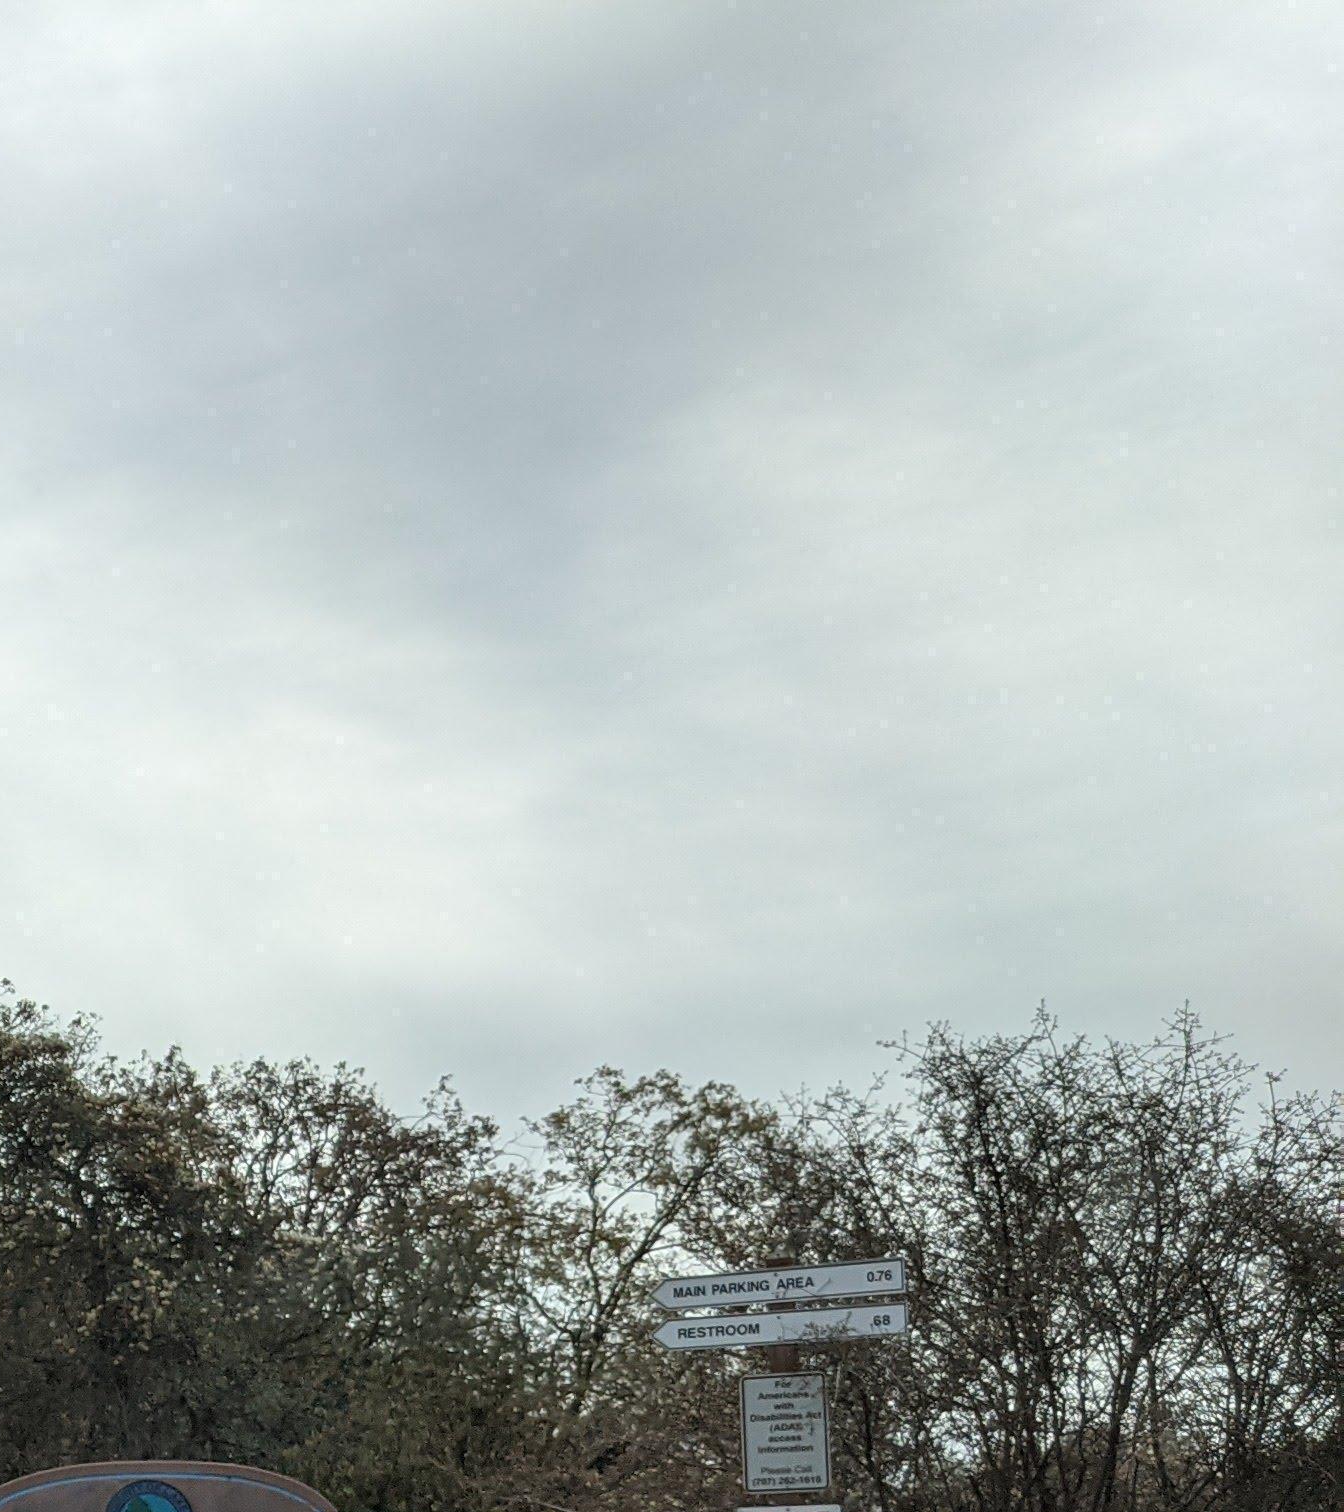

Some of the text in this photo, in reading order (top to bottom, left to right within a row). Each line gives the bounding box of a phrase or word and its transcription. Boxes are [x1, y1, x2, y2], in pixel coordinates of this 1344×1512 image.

[673, 1270, 892, 1298] MAIN PARKING AREA 0.76
[677, 1323, 760, 1340] RESTROOM
[774, 1402, 794, 1410] with
